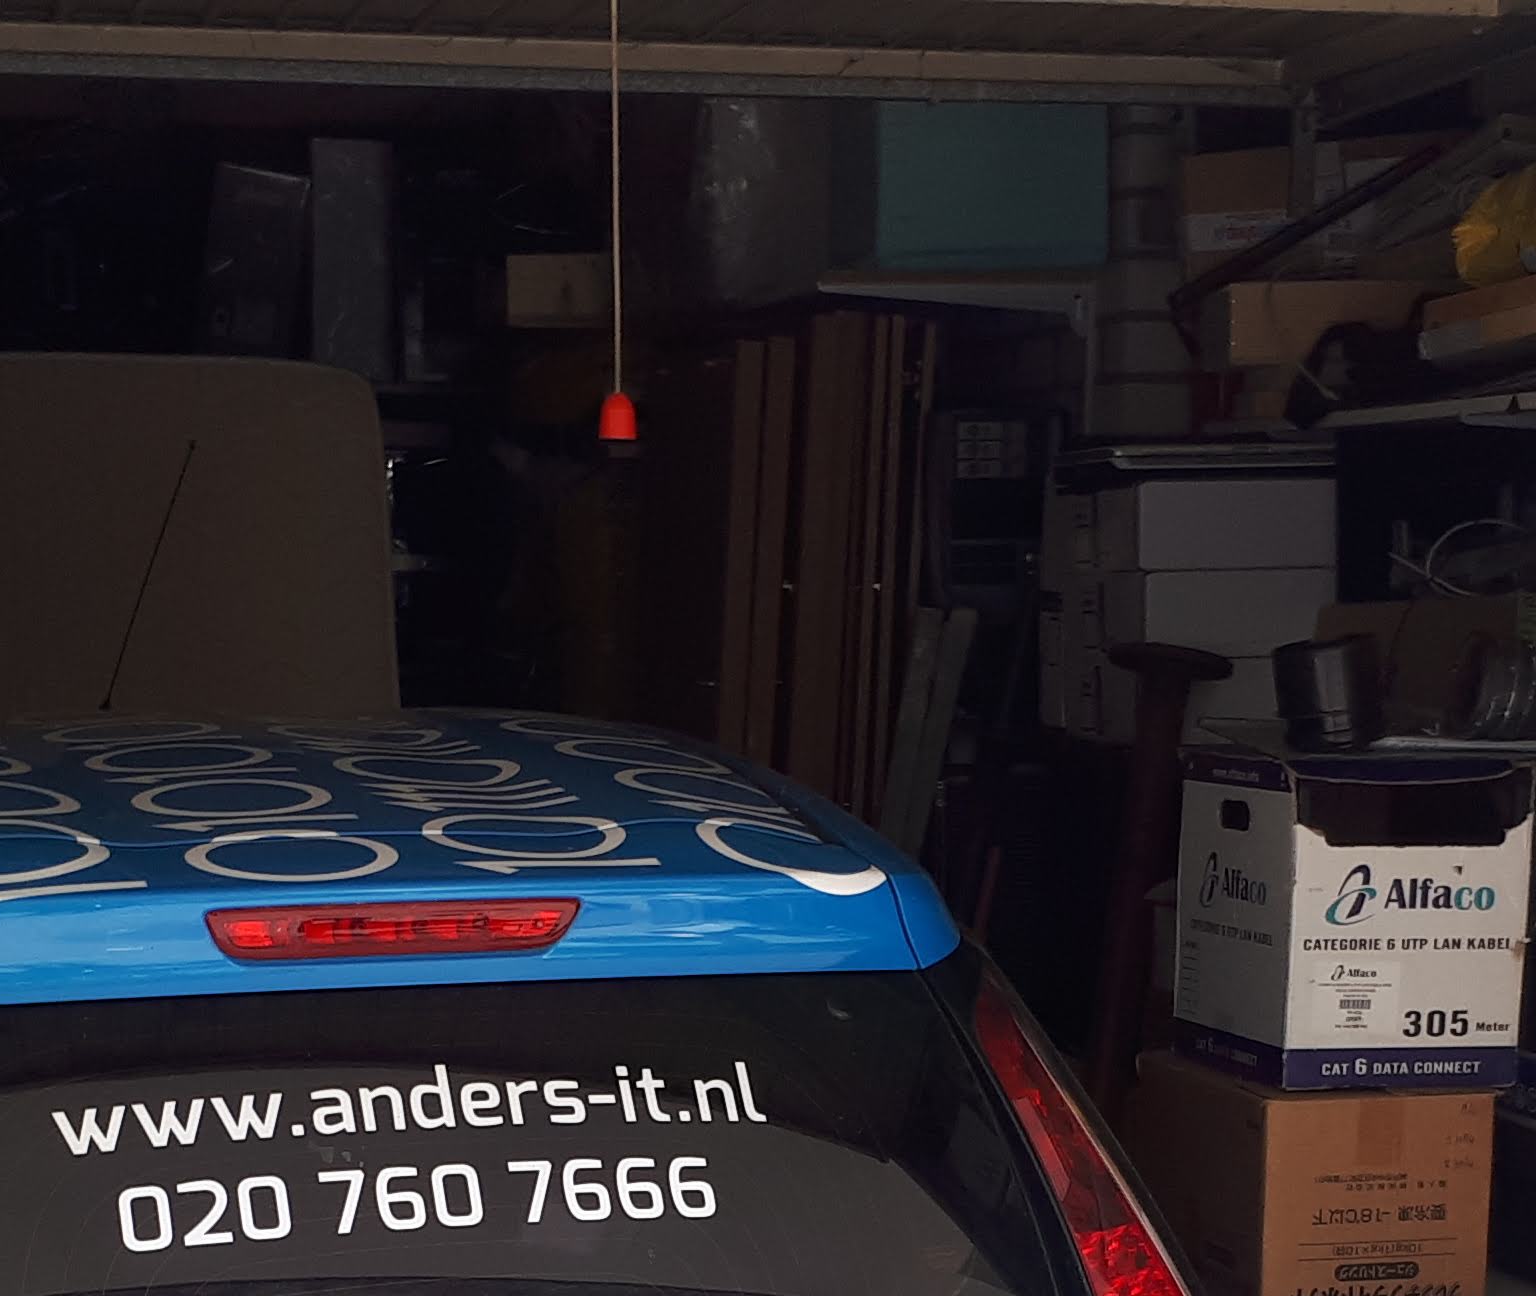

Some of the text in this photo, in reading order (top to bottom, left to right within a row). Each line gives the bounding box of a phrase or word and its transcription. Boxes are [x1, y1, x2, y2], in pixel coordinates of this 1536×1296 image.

[1221, 866, 1267, 906] Alfaco
[1384, 877, 1496, 911] Alfaco
[1303, 938, 1382, 951] CATEGORIE
[1387, 938, 1396, 950] 6
[1401, 938, 1428, 950] UTP
[1433, 938, 1462, 950] LAN
[1346, 967, 1377, 978] Alfaco
[1402, 1009, 1512, 1038] 305 Meter
[1321, 1058, 1481, 1076] CAT 6 DATA CONNECT
[52, 1061, 768, 1156] www.anders-it.nl
[117, 1156, 717, 1253] 020 760 7666
